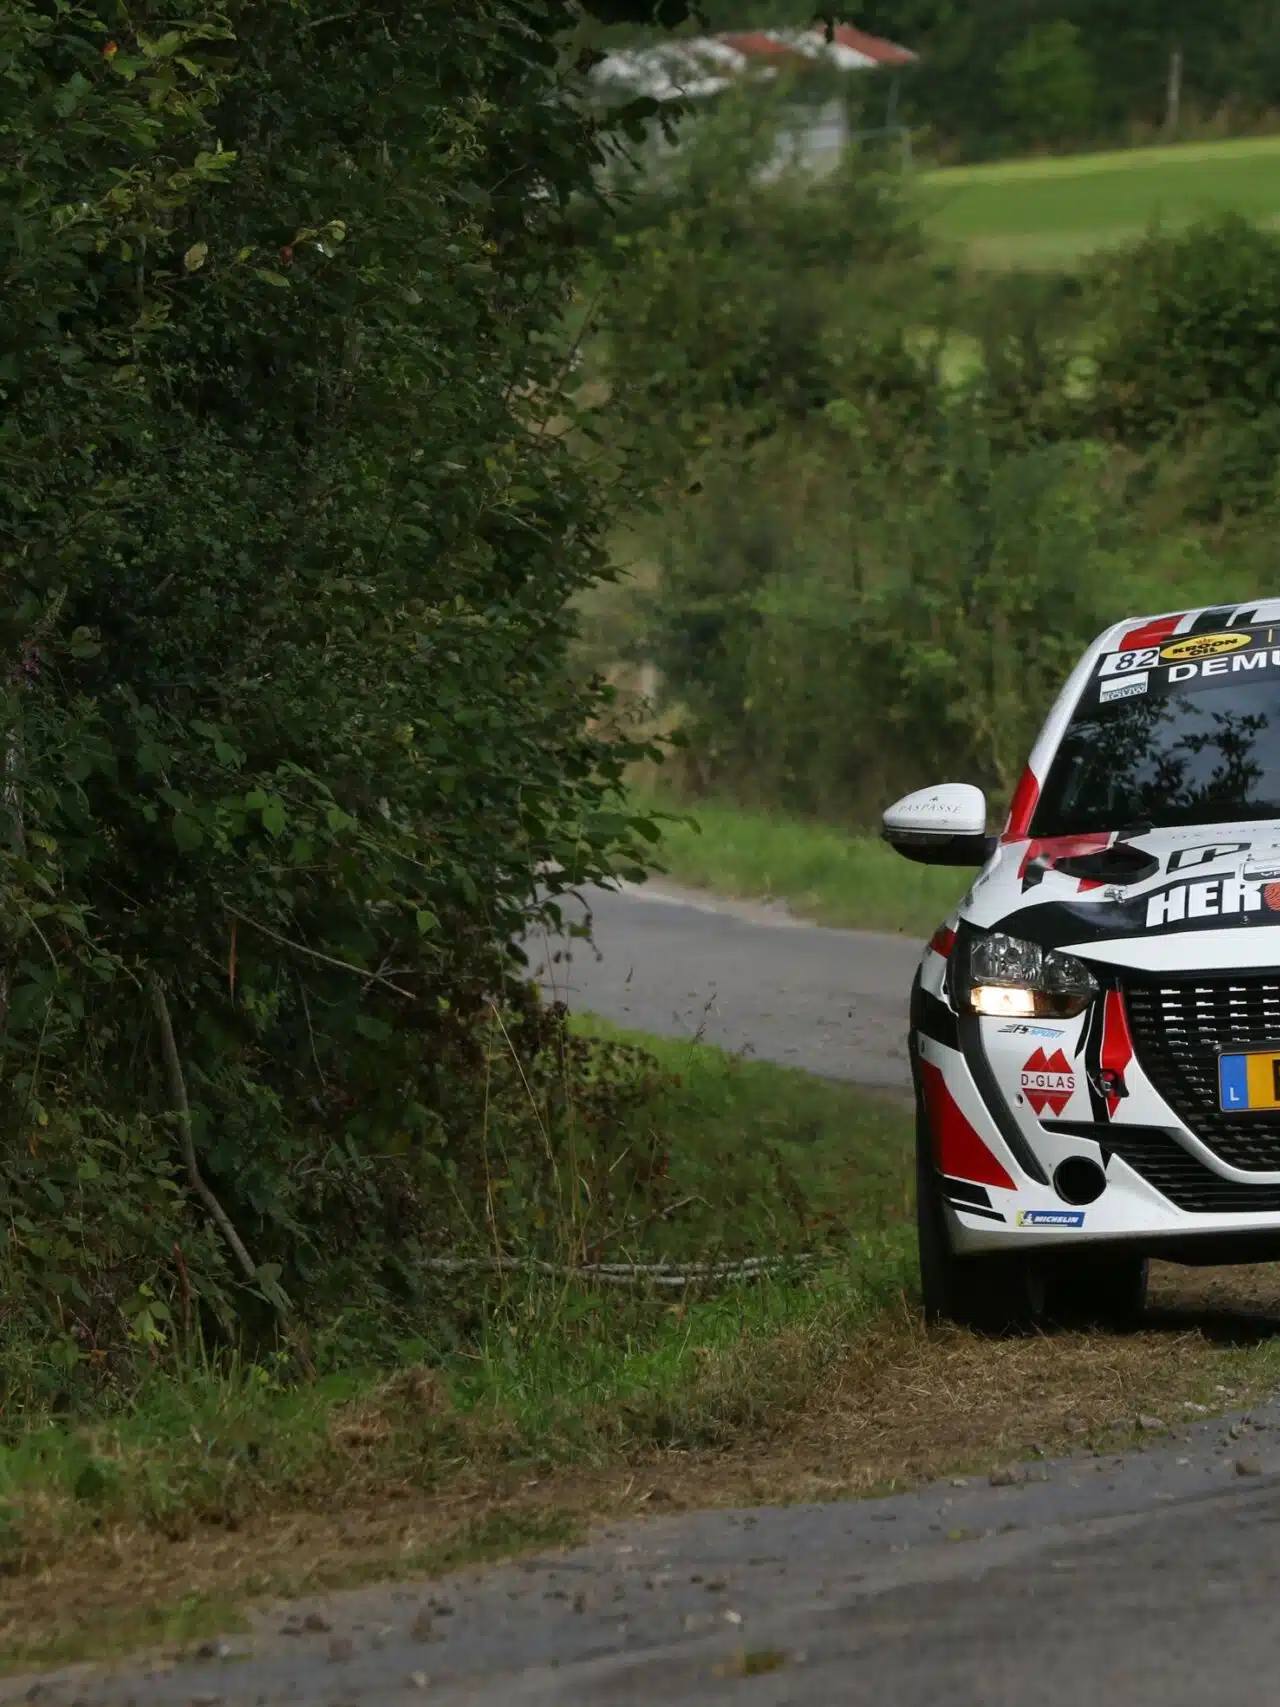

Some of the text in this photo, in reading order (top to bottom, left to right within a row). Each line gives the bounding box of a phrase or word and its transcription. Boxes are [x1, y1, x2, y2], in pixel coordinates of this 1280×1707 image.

[1172, 638, 1238, 655] KROON
[1189, 647, 1218, 656] OIL
[1115, 650, 1156, 671] 82
[1020, 1074, 1075, 1090] D-GLAS
[1229, 1087, 1240, 1101] L
[1033, 1214, 1079, 1225] MICHELIN
